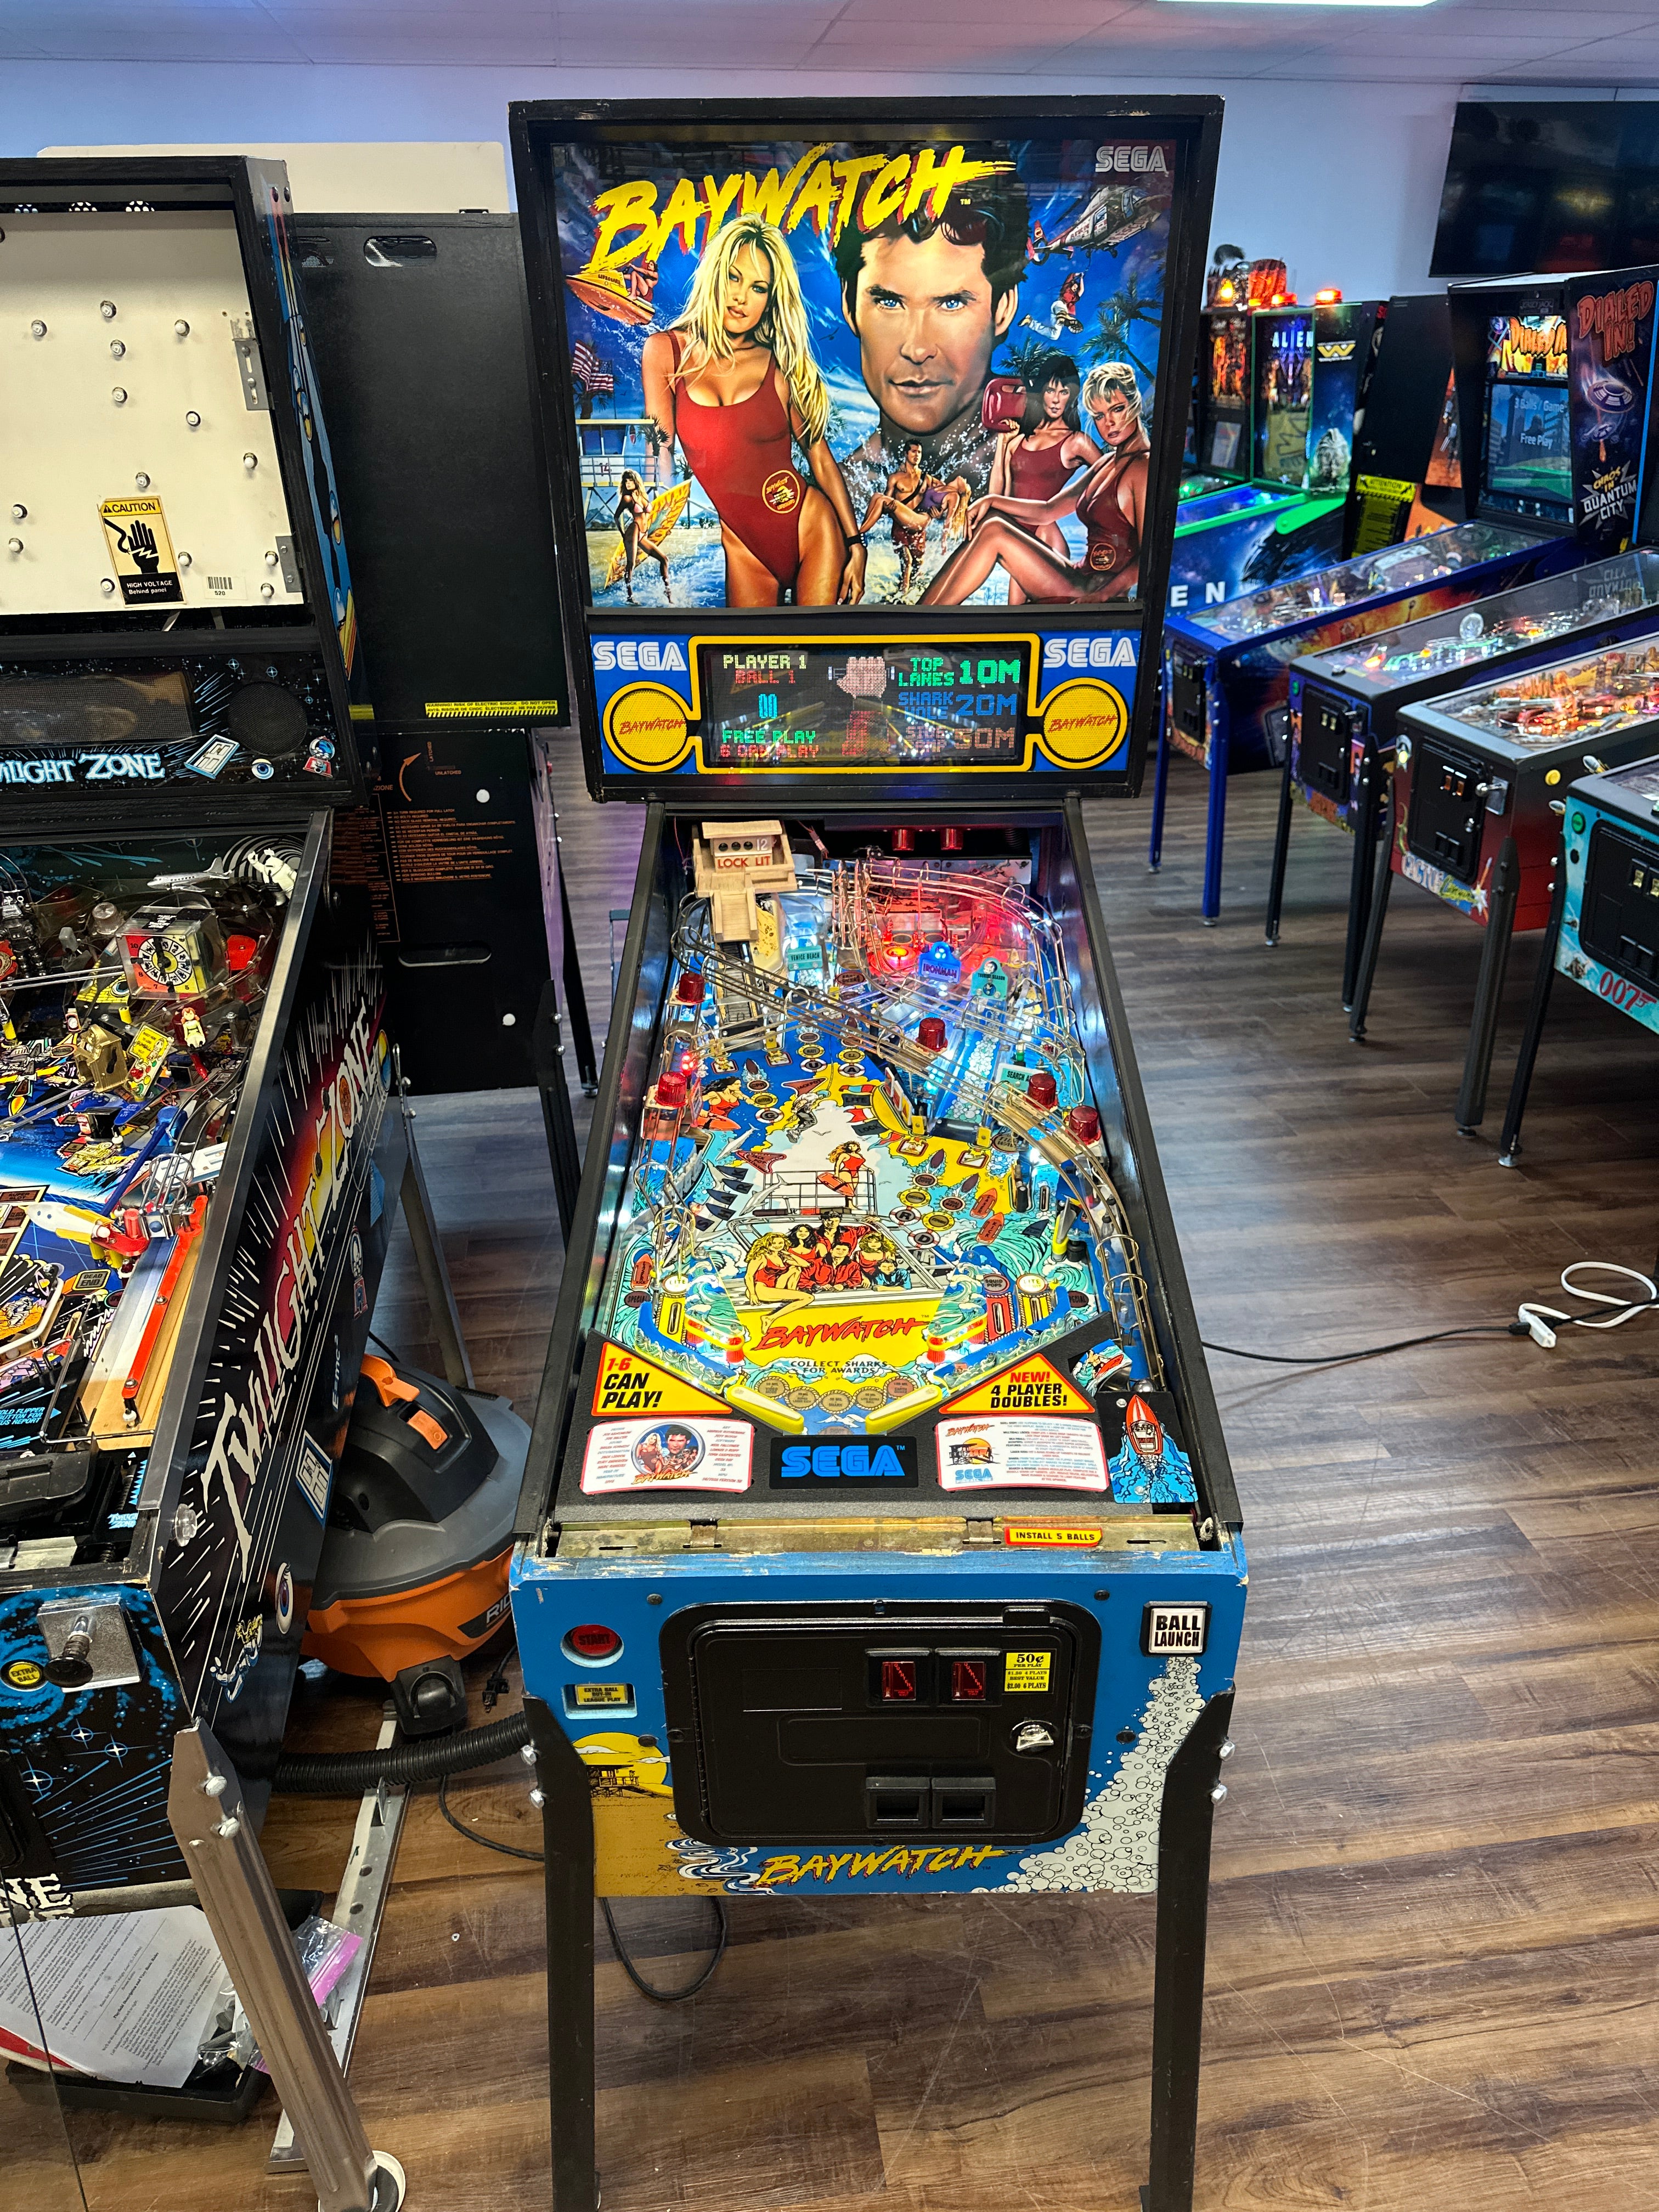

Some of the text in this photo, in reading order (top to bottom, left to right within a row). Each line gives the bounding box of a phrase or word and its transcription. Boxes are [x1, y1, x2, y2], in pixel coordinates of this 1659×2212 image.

[1095, 146, 1166, 172] SEGA
[580, 142, 1016, 273] BAYWATCH
[1577, 281, 1654, 338] DIALED
[1509, 317, 1556, 354] DIALED
[1605, 324, 1635, 362] IN!
[1520, 398, 1537, 411] Balls
[1543, 400, 1564, 413] Game
[1520, 432, 1553, 449] Free Play
[598, 462, 610, 475] 14
[1593, 466, 1621, 489] CHAOS
[1604, 479, 1614, 493] IN
[1583, 479, 1637, 513] QUANTUM
[112, 501, 156, 514] CAUTION
[1600, 498, 1623, 520] CITY
[127, 579, 173, 589] HIGH VOLTAGE
[592, 641, 687, 671] SEGA
[1043, 636, 1137, 668] SEGA
[723, 654, 806, 669] PLAYER 1
[910, 657, 944, 672] TOP
[735, 670, 795, 684] BALL 1
[898, 672, 955, 686] LANES
[959, 659, 1021, 684] 10M
[898, 691, 954, 706] SHARK
[955, 693, 1018, 716] 20M
[619, 716, 687, 736] BAYWATCH
[1047, 713, 1118, 733] BAYWATCH
[722, 730, 816, 744] FREE PLAY
[954, 727, 1015, 749] 50M
[720, 744, 730, 758] 6
[776, 745, 819, 758] PLAY
[0, 753, 165, 784] ILIGHT ZONE
[756, 838, 769, 851] 12
[717, 855, 771, 869] LOCK LIT
[923, 963, 957, 978] IRONMAN
[1599, 970, 1646, 1013] 007
[1007, 1070, 1025, 1082] SEARCH
[857, 1122, 881, 1134] LOCK
[899, 1212, 912, 1221] R
[984, 1221, 996, 1238] KICK
[918, 1234, 929, 1242] D
[201, 1174, 326, 1583] TWILIGHT
[316, 998, 381, 1211] ZONE
[753, 1314, 933, 1351] BAYWATCH
[606, 1357, 633, 1372] 1-6
[603, 1373, 650, 1390] CAN
[1010, 1372, 1050, 1384] NEW!
[991, 1383, 1063, 1396] 4 PLAYER
[601, 1391, 663, 1409] PLAY!
[990, 1395, 1068, 1409] DOUBLES!
[945, 1423, 995, 1437] BAYWATCH
[781, 1444, 906, 1477] SEGA
[631, 1470, 693, 1485] BAYWATCH
[955, 1468, 993, 1479] SEGA
[1015, 1531, 1053, 1540] INSTALL
[1067, 1533, 1096, 1541] BALLS
[1155, 1615, 1201, 1631] BALL
[578, 1633, 611, 1645] START
[1154, 1631, 1200, 1647] LAUNCH
[1016, 1654, 1045, 1664] 50¢
[10, 1667, 38, 1680] EXTRA
[17, 1673, 37, 1683] BALL
[893, 1663, 913, 1691] QUARTERS
[963, 1662, 983, 1690] QUARTERS
[752, 1844, 1015, 1889] BAYWATCH
